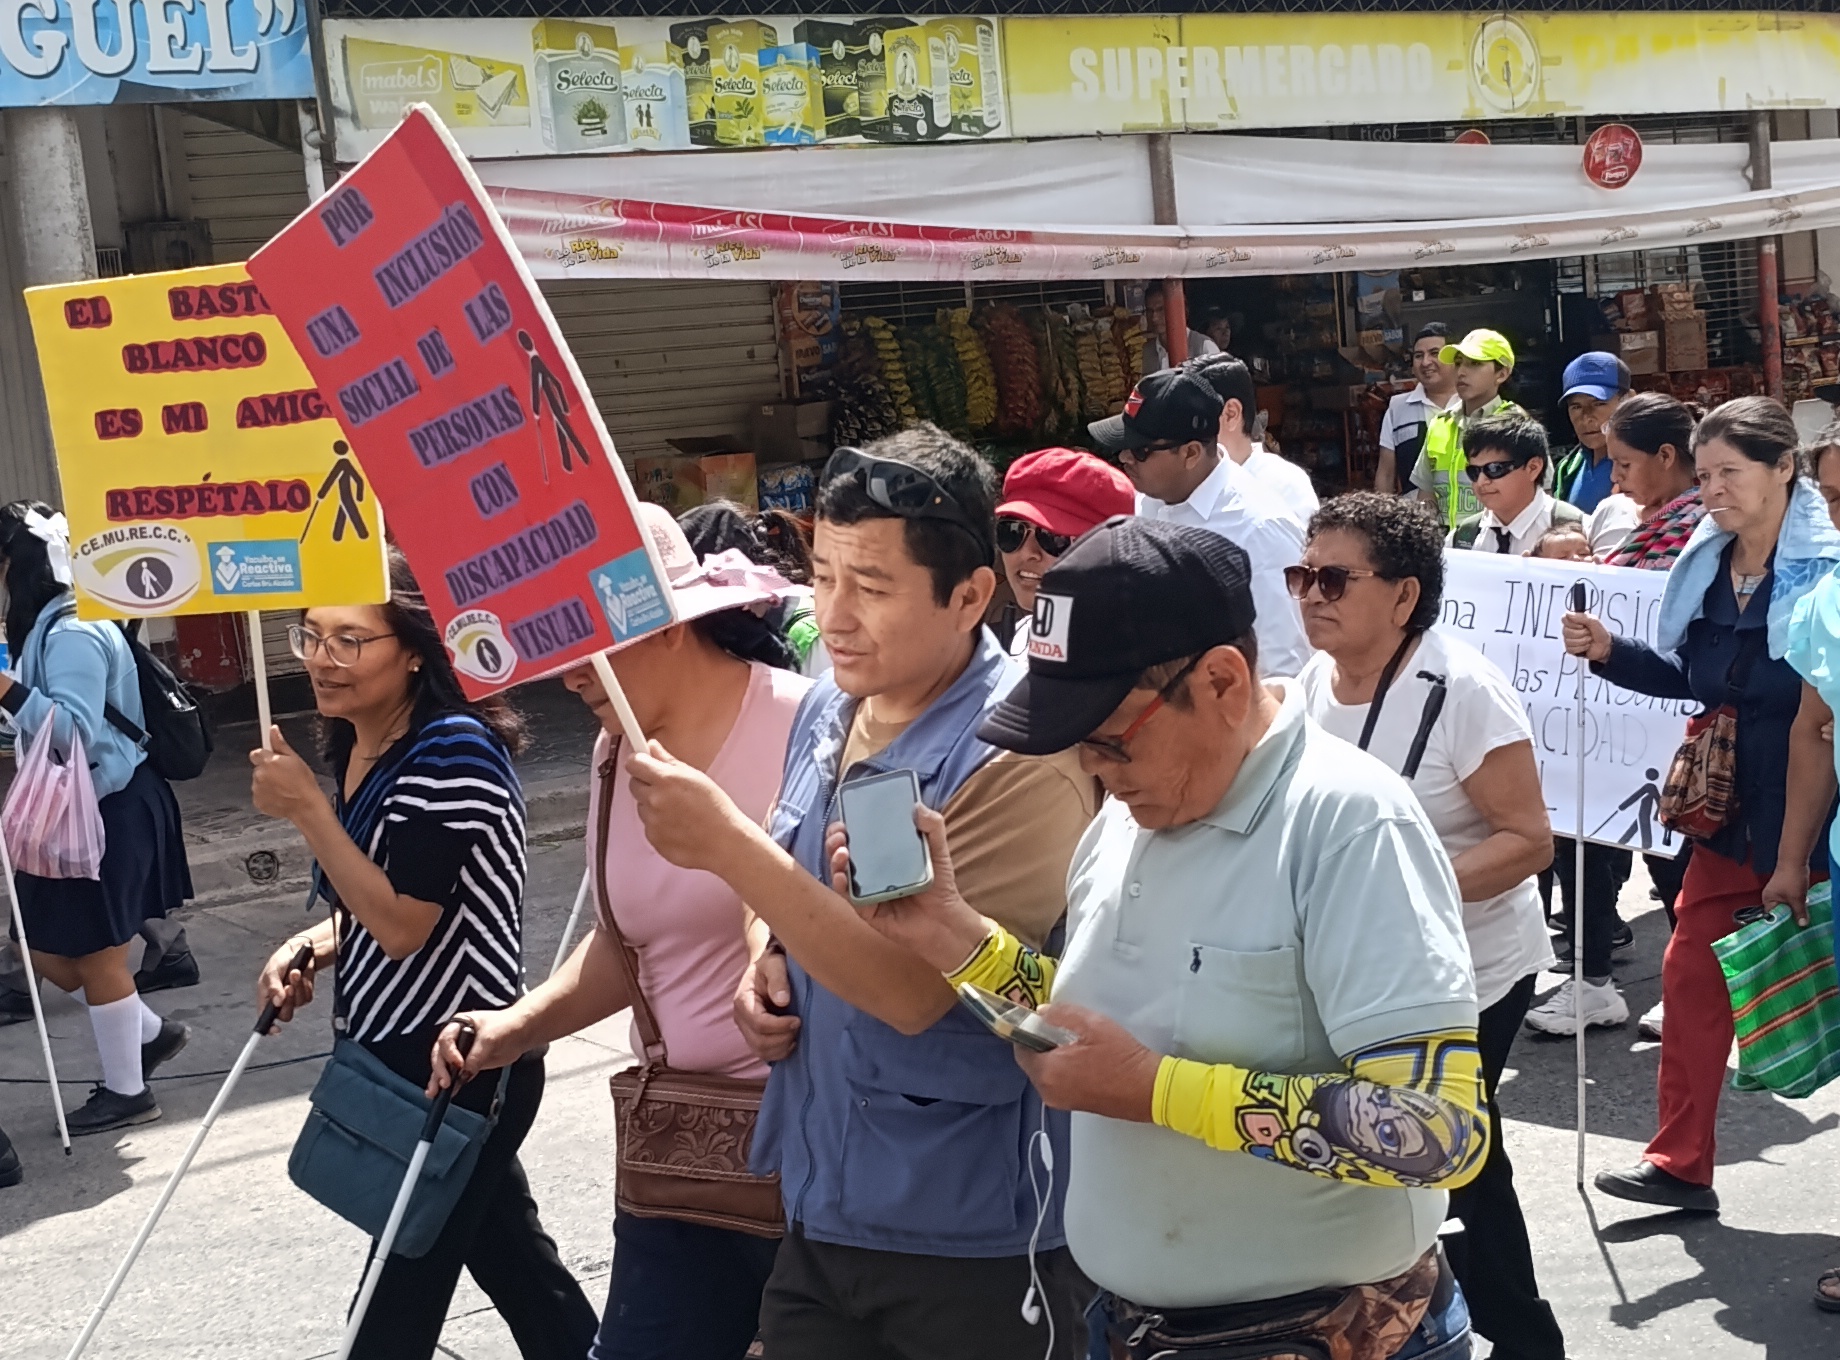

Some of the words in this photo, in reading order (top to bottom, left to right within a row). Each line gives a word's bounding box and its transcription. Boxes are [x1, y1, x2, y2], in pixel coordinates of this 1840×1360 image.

[557, 69, 615, 91] Selecta
[715, 75, 755, 93] Selecta
[762, 75, 804, 93] Selecta
[820, 70, 858, 86] Select
[1069, 43, 1434, 101] SUPERMERCADO
[320, 187, 374, 247] POR
[570, 239, 598, 253] Rico
[588, 247, 619, 260] Vida
[732, 248, 761, 261] Vida
[306, 304, 360, 356] UNA
[374, 203, 484, 308] INCLUSIÓN
[67, 298, 111, 327] EL
[124, 334, 267, 373] BLANCO
[338, 359, 420, 425] SOCIAL
[417, 329, 454, 376] DE
[464, 283, 511, 341] LAS
[97, 409, 142, 439] ES
[163, 403, 207, 433] MI
[238, 390, 331, 429] AMIG
[409, 388, 525, 467] PERSONAS
[108, 472, 311, 519] RESPÉTALO
[470, 462, 519, 516] CON
[240, 562, 293, 575] Reactiva
[445, 501, 598, 607] DISCAPACIDAD
[511, 598, 595, 660] VISUAL
[1442, 599, 1476, 630] na
[1029, 640, 1065, 658] NDA
[1512, 643, 1549, 693] las
